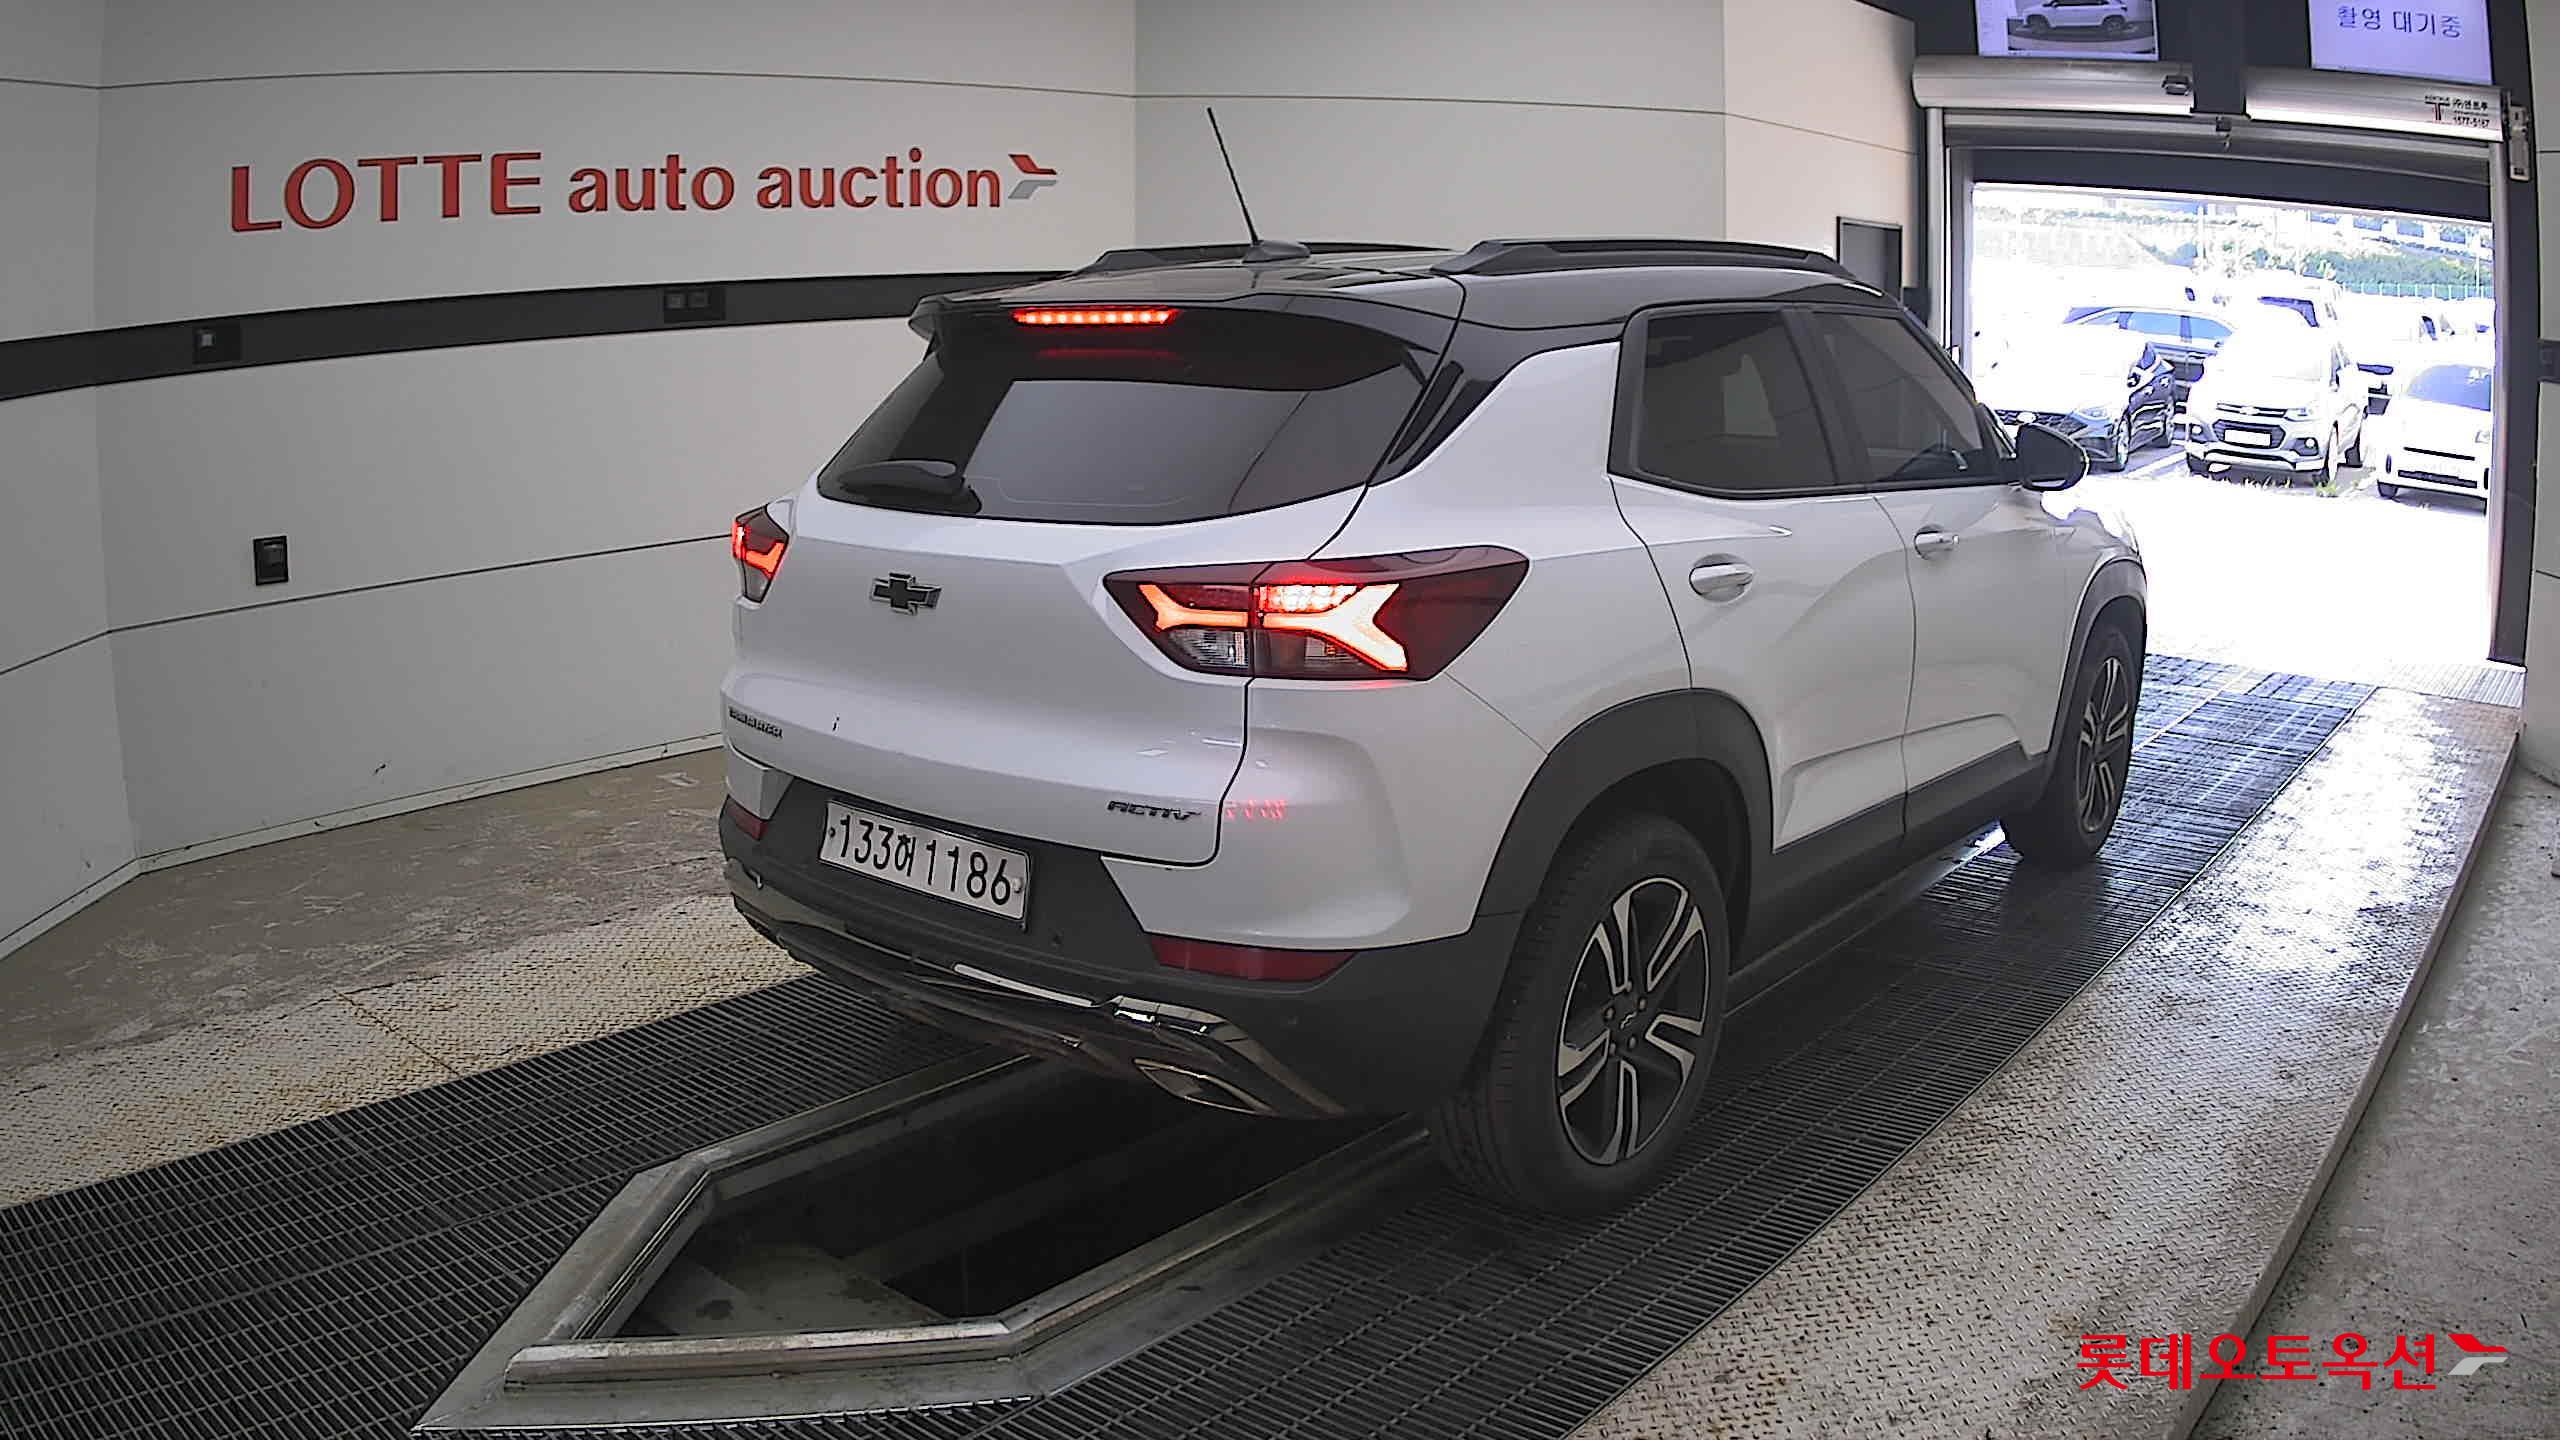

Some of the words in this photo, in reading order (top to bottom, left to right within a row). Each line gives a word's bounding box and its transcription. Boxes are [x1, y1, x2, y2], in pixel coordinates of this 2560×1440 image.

[2338, 6, 2382, 31] 촬영
[2393, 11, 2461, 38] 대기중
[231, 152, 542, 232] LOTTE
[568, 153, 736, 213] auto
[756, 147, 1001, 209] auction
[1107, 800, 1202, 821] ACTIV
[840, 814, 1012, 906] 133허1186
